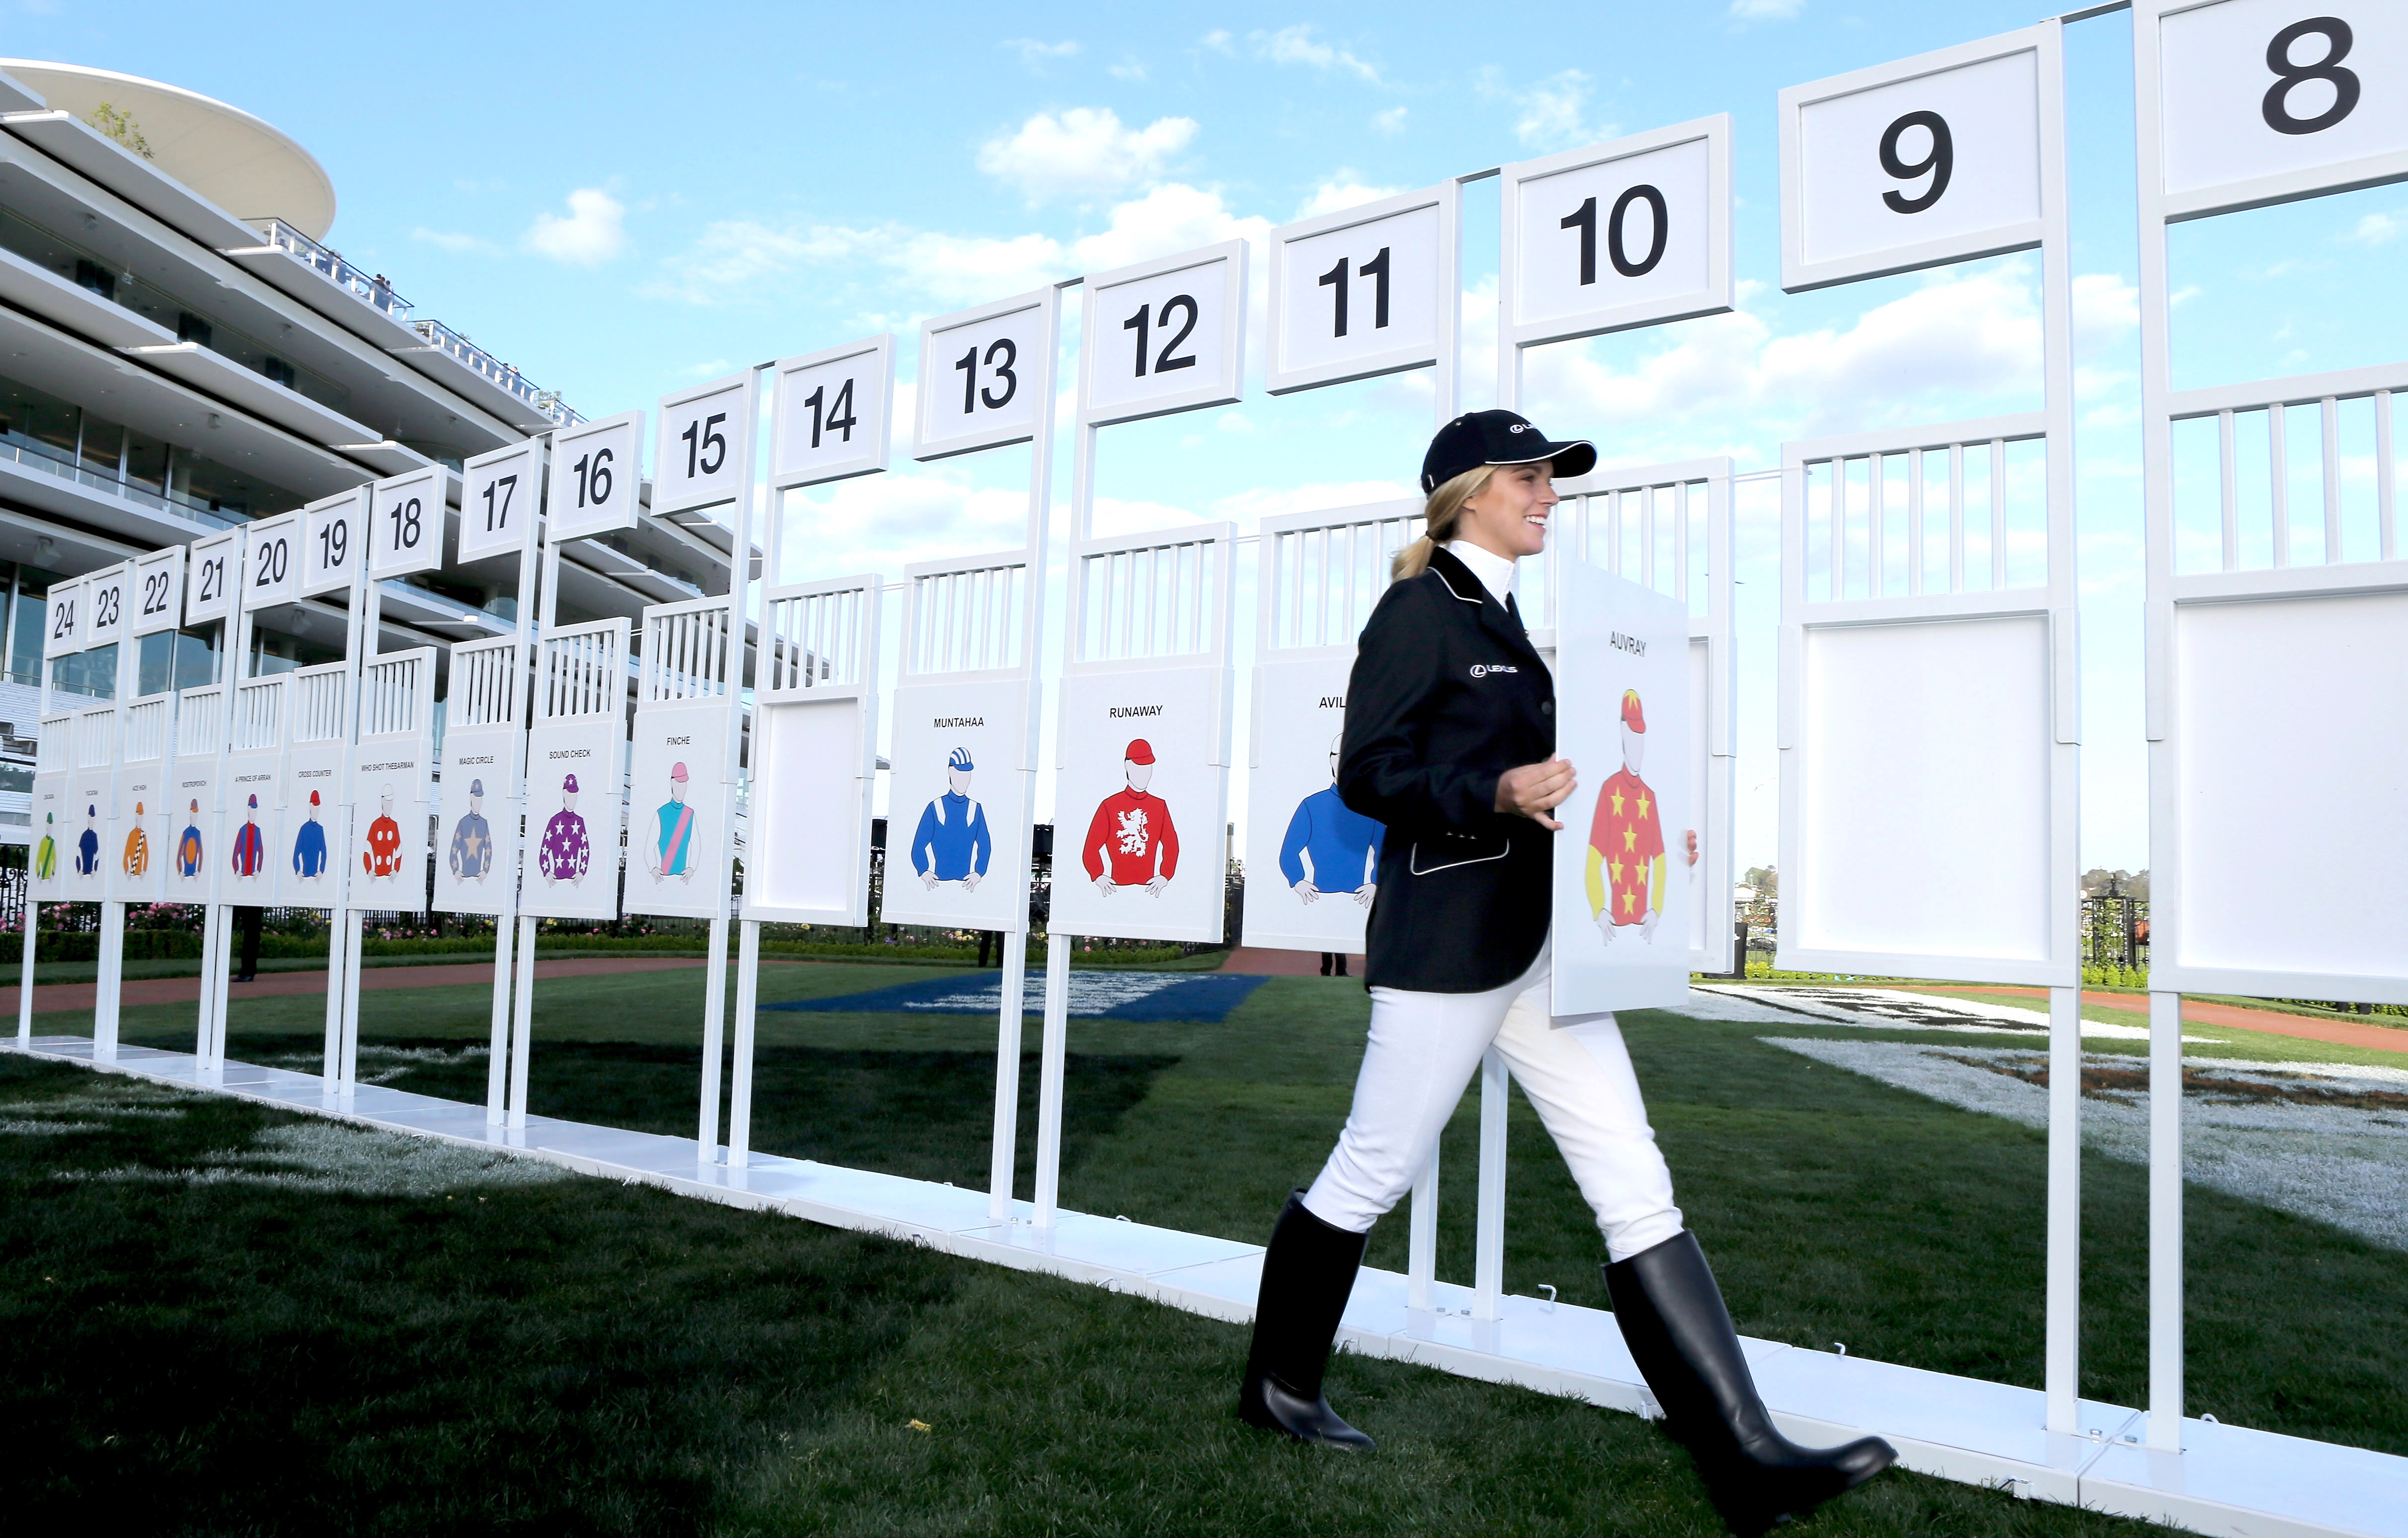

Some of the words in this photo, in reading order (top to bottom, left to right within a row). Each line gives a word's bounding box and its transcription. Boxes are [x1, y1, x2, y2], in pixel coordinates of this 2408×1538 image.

[2262, 17, 2360, 135] 8
[1880, 111, 1953, 214] 9
[1560, 185, 1668, 285] 10
[1319, 247, 1389, 338] 11
[1124, 295, 1198, 377] 12
[956, 339, 1016, 414] 13
[805, 379, 856, 448] 14
[683, 412, 726, 478] 15
[574, 448, 613, 508] 16
[391, 498, 421, 551] 18
[483, 475, 517, 531] 17
[256, 538, 287, 586] 20
[320, 519, 347, 569] 19
[144, 571, 168, 615] 22
[200, 557, 223, 602] 21
[54, 600, 73, 639] 24
[97, 587, 119, 628] 23
[1610, 631, 1646, 657] AUVRAY
[1486, 665, 1518, 673] LEXUS
[934, 717, 984, 728] MUNTAHAA
[1110, 705, 1163, 718] RUNAWAY
[1319, 697, 1346, 708] AVIL
[476, 756, 494, 764] CIRCLE
[549, 750, 569, 759] SOUND
[571, 749, 591, 758] CHECK
[667, 736, 690, 745] FINCHE
